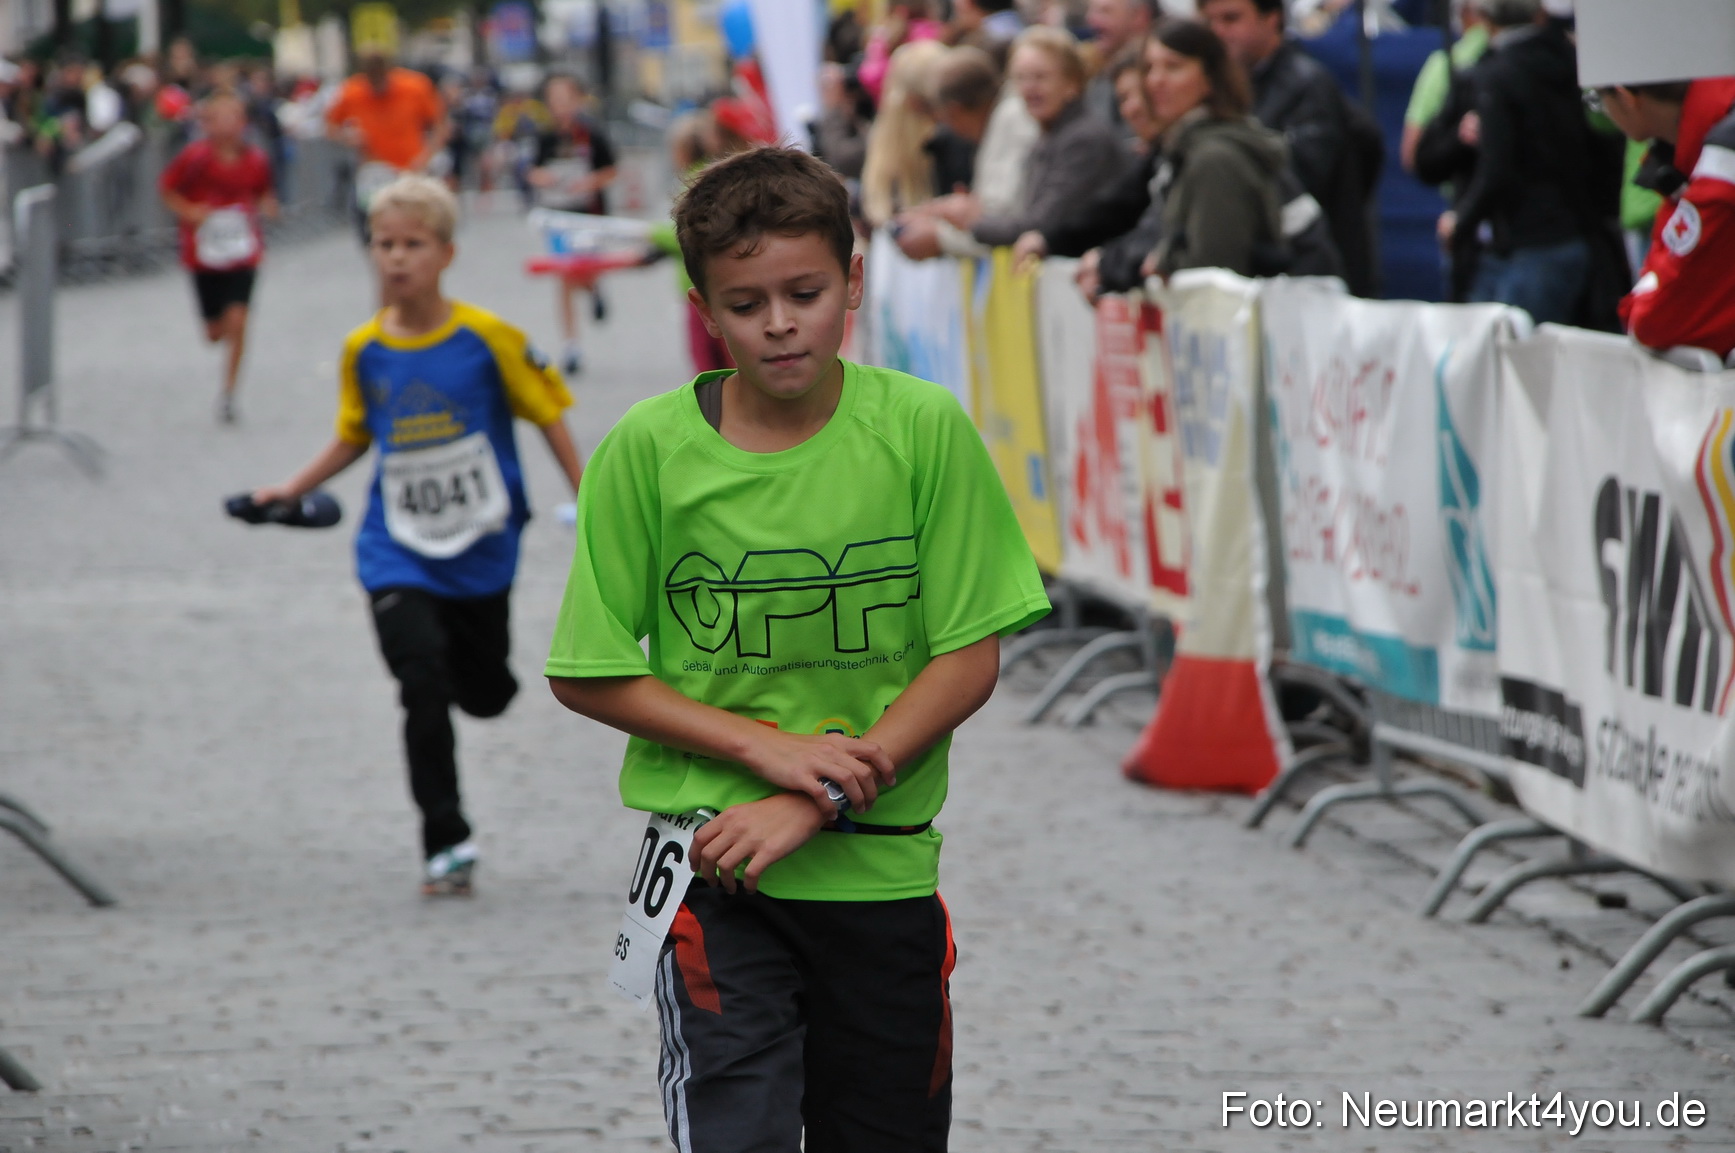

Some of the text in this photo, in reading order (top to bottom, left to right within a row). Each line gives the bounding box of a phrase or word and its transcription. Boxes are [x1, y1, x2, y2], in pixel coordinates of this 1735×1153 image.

[397, 468, 489, 515] 4041
[714, 664, 738, 676] und
[741, 653, 889, 676] Automatisierungstechnik
[657, 809, 694, 831] arkt
[628, 826, 684, 919] 06
[613, 930, 630, 961] es
